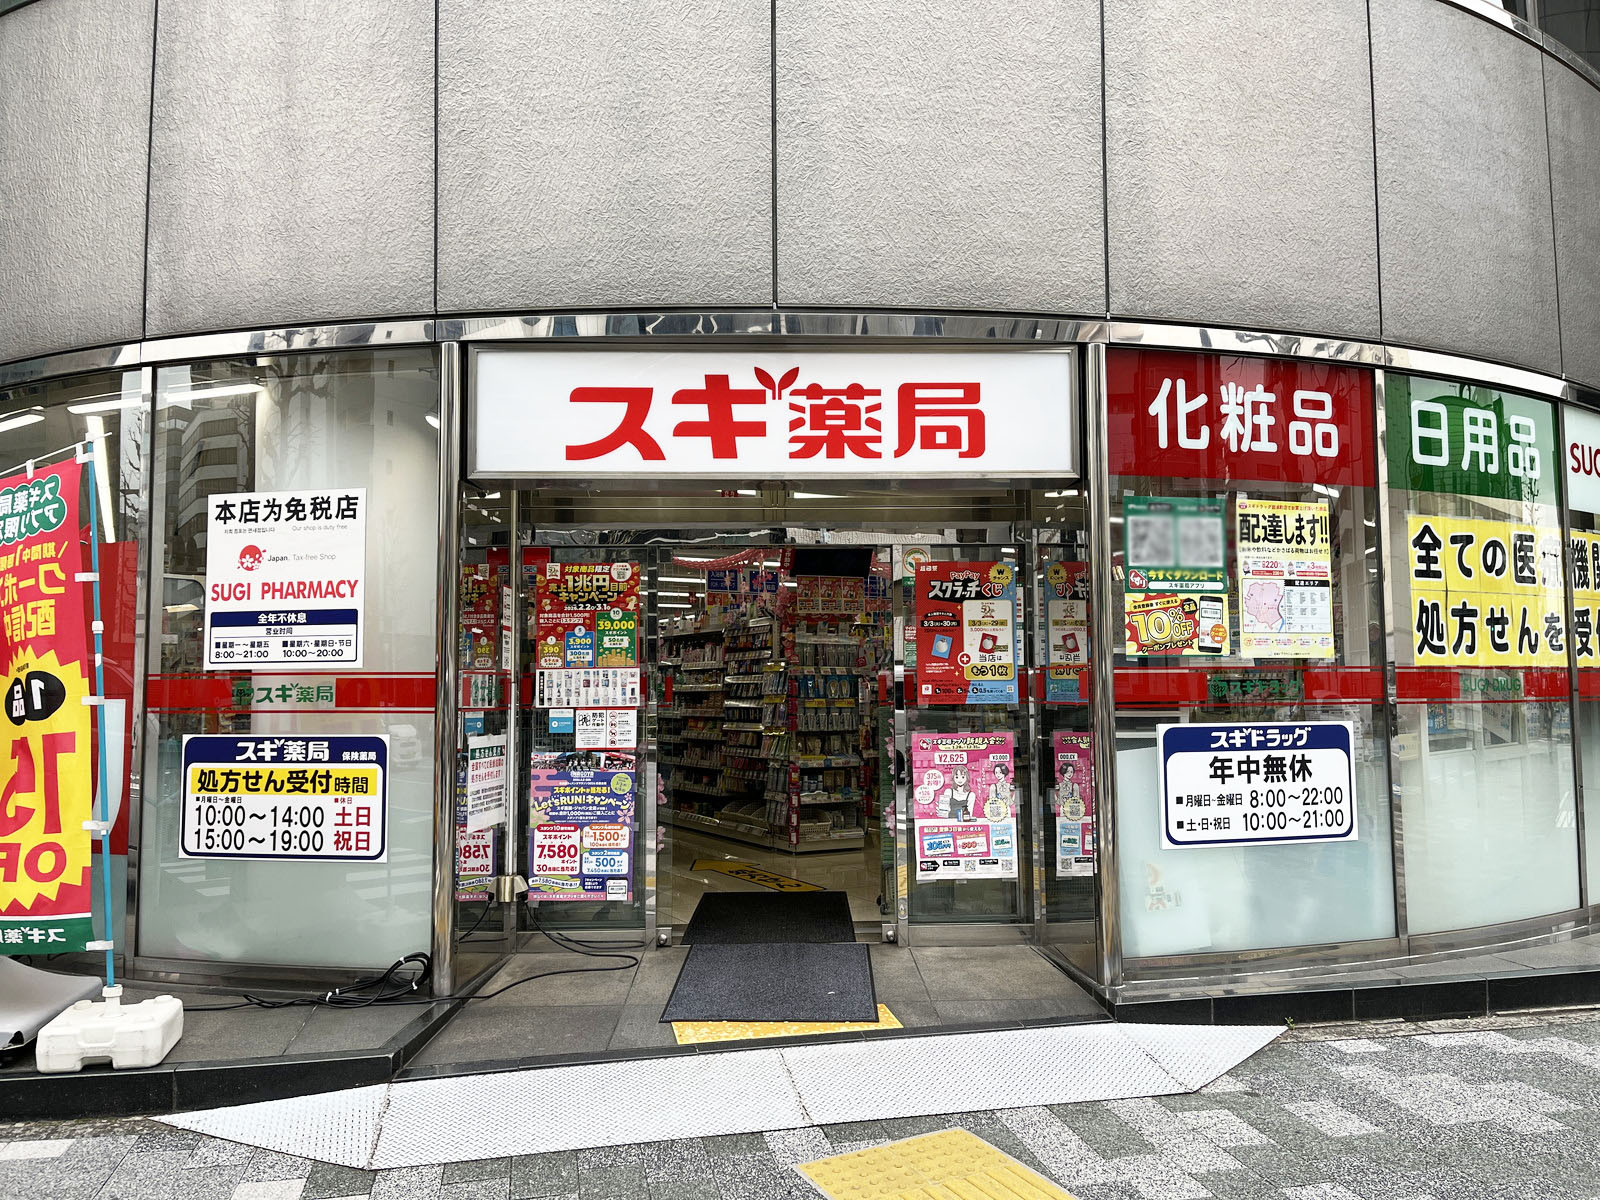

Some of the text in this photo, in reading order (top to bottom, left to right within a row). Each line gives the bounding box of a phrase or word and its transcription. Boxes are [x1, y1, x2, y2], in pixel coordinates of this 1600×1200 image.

[565, 366, 986, 461] スギ薬局
[1148, 378, 1339, 457] 化粧品
[1411, 400, 1540, 480] 日用品
[215, 495, 359, 525] 本店为免税店
[303, 525, 317, 533] shop
[323, 524, 335, 532] duty
[292, 553, 318, 561] Tax-free
[319, 553, 336, 562] Shop
[949, 570, 981, 581] PayPay
[1148, 571, 1223, 581] 今すぐダウンロード
[211, 579, 359, 602] SUGI PHARMACY
[928, 580, 1003, 598] スクラッチくじ
[558, 591, 618, 603] キャンペーン
[257, 612, 308, 624] 全年不休息
[265, 627, 293, 635] 营业时间
[597, 621, 635, 630] 39,000
[1172, 621, 1193, 638] OFF
[543, 646, 559, 654] 390
[1141, 640, 1194, 654] クーポンプレゼント
[971, 665, 1008, 676] もう1枚
[255, 682, 334, 704] スギ薬局
[1230, 680, 1299, 696] スギドラッグ
[1210, 726, 1312, 748] スギドラッグ
[236, 738, 330, 762] スギ薬局
[341, 751, 377, 761] 保険薬局
[1208, 754, 1313, 784] 年中無休
[339, 797, 353, 805] 休日
[333, 830, 371, 852] 祝日
[593, 831, 620, 841] 1,500
[536, 844, 578, 860] 7,580
[595, 858, 616, 867] 500
